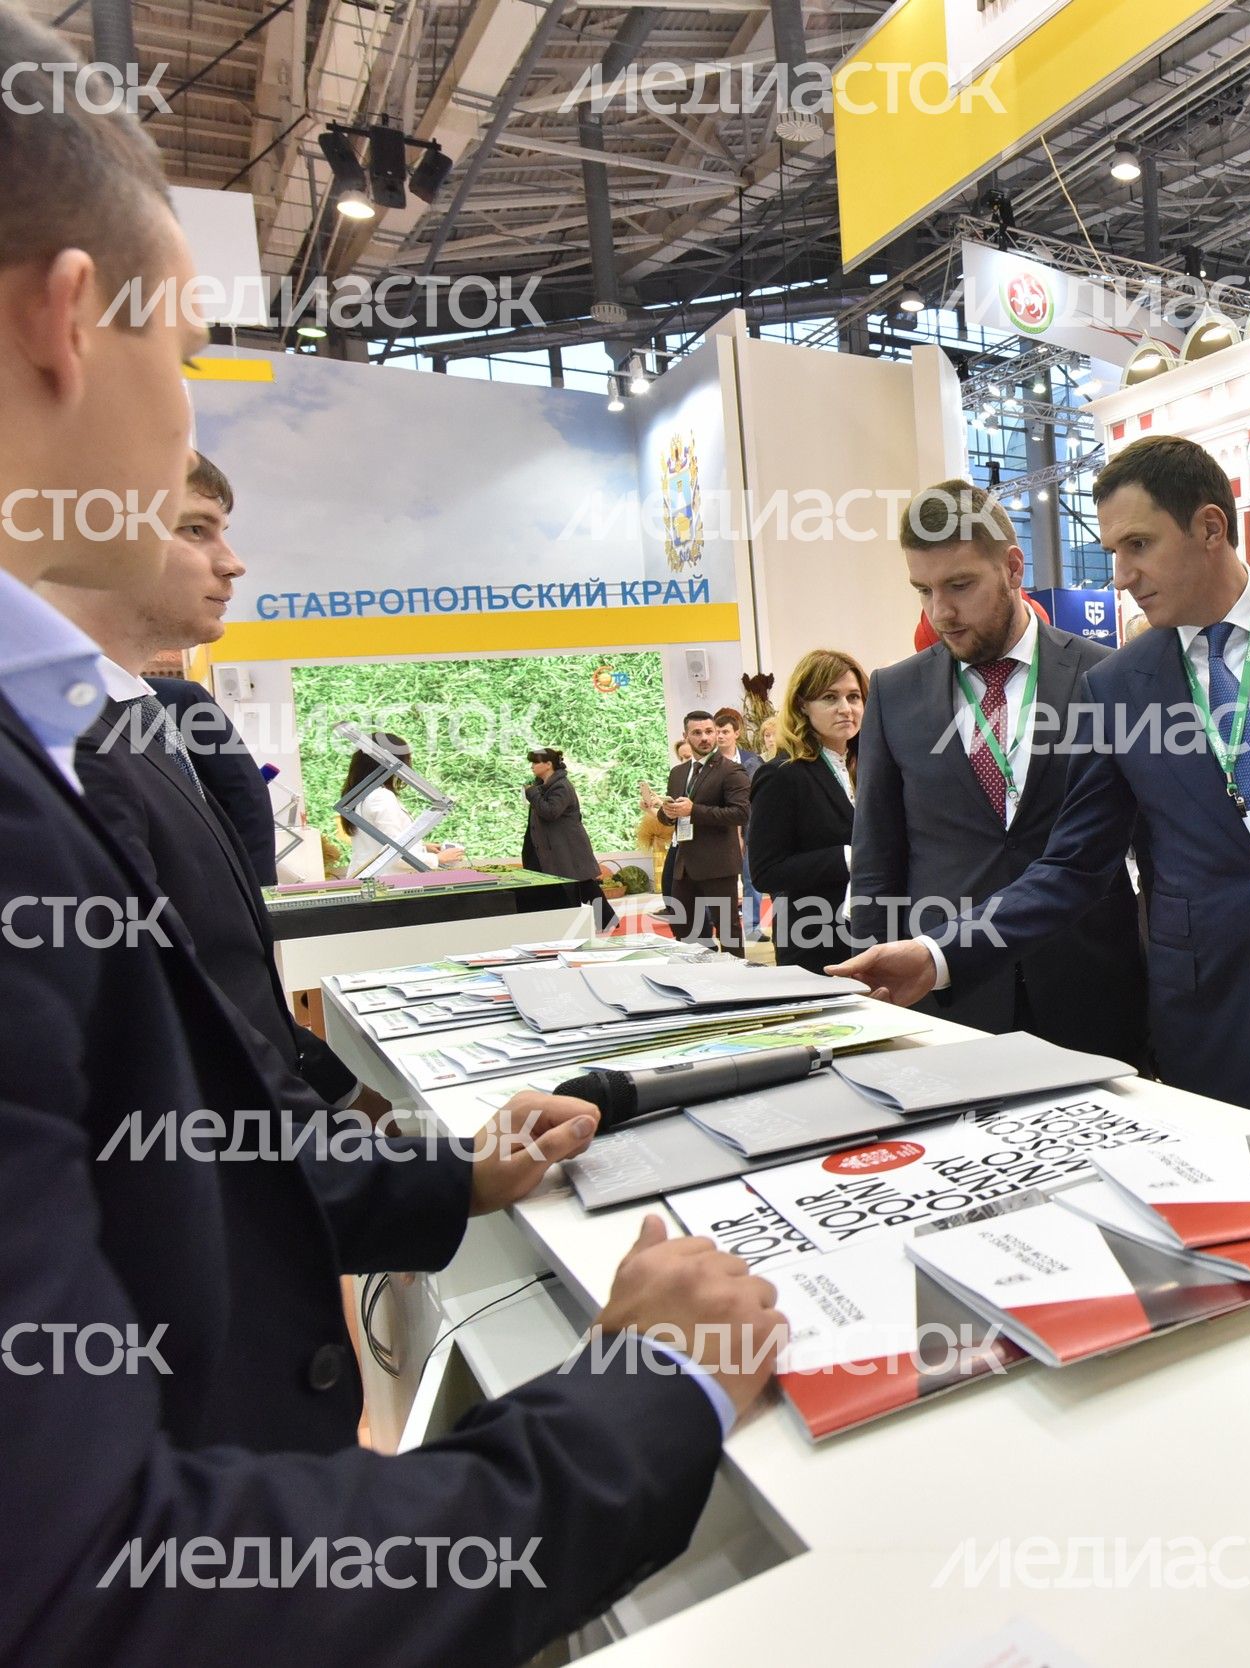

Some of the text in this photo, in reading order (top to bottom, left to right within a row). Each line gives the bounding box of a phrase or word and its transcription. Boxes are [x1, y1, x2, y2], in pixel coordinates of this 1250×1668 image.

[256, 574, 711, 620] СТАВРОПОЛЬСКИЙ КРАЙ
[971, 1110, 1092, 1173] MOSCOW
[1055, 1101, 1181, 1145] MARKET
[923, 1155, 1021, 1200] ENTRY
[981, 1151, 1063, 1187] INTO
[795, 1189, 880, 1241] YOUR
[835, 1177, 932, 1226] POINT
[911, 1187, 973, 1211] OF
[711, 1213, 792, 1267] YOUR
